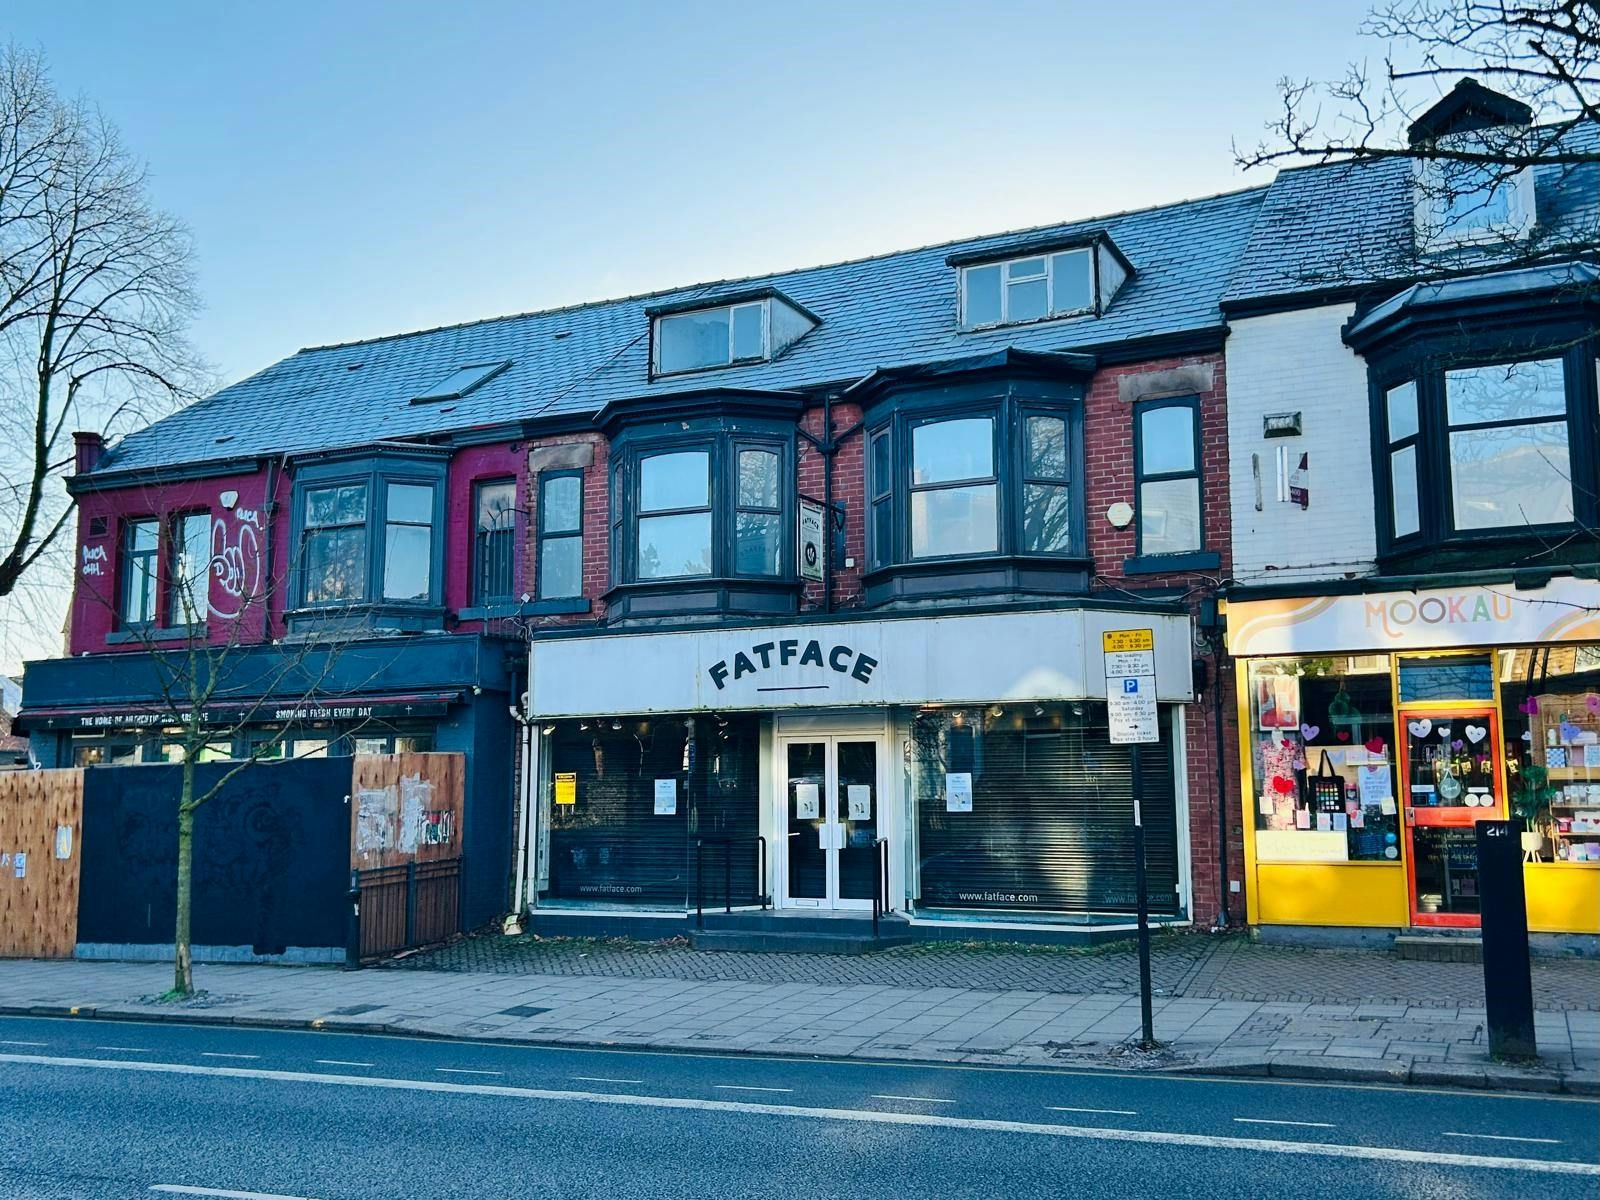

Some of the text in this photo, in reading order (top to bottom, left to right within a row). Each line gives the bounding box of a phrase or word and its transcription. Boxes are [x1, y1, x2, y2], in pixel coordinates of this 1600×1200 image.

[1364, 593, 1513, 638] MOOKAU
[708, 639, 878, 690] FATFACE
[333, 707, 356, 717] EVERY
[358, 707, 373, 716] DAY
[81, 717, 93, 726] THE
[580, 884, 643, 893] www.fatface.com
[959, 891, 1039, 902] www.fatface.com
